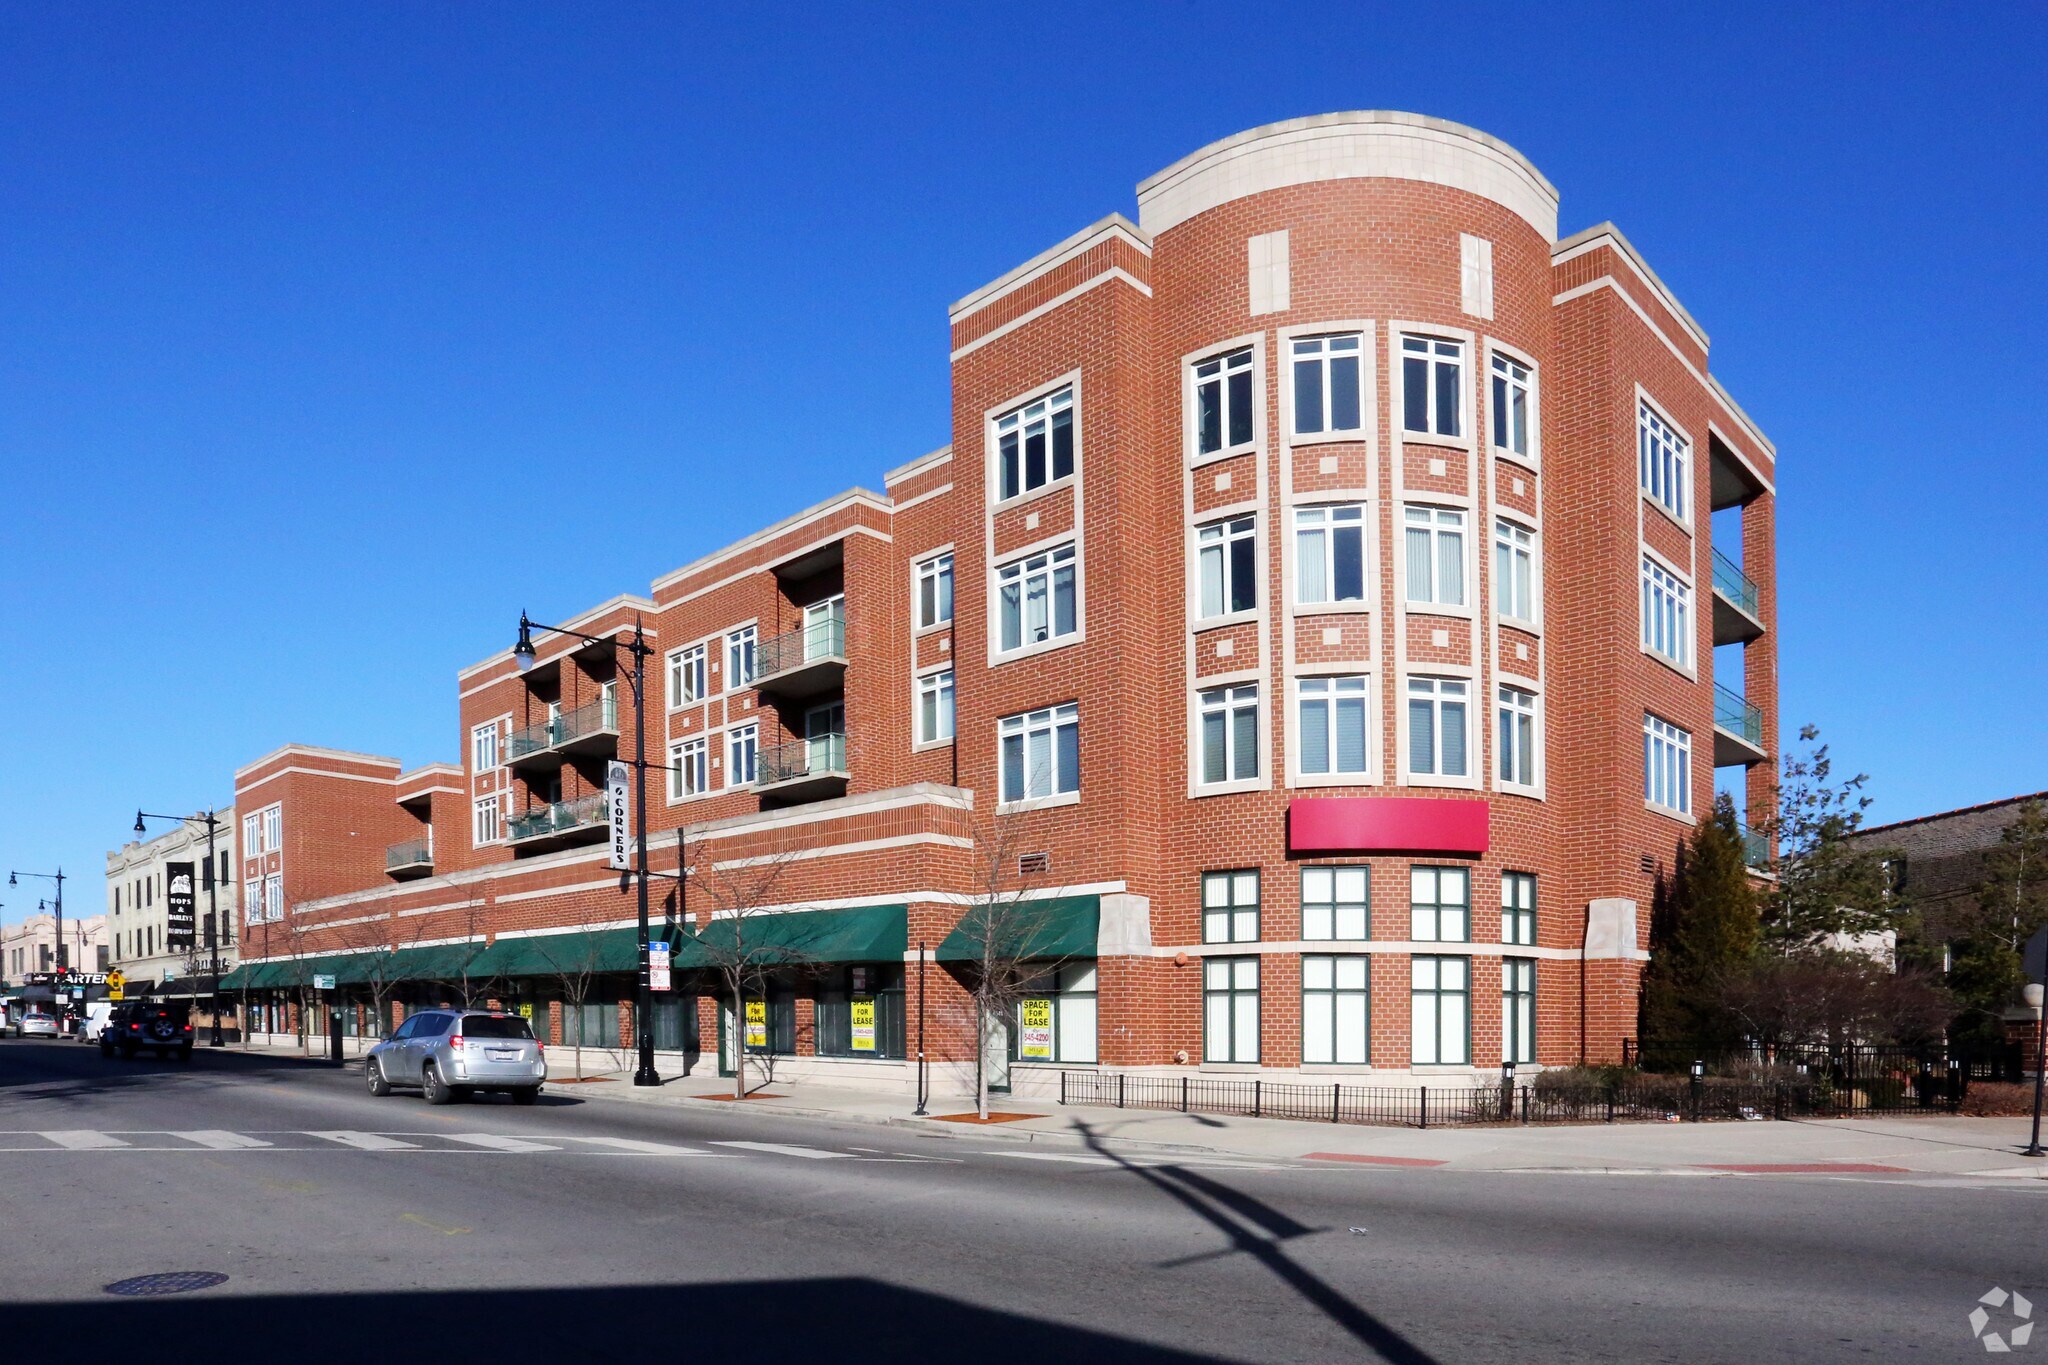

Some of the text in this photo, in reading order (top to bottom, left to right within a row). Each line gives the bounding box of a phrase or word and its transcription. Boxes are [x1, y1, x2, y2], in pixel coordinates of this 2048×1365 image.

[615, 798, 624, 863] CORNERS
[170, 897, 192, 905] HOPS
[1023, 1001, 1049, 1009] SPACE
[857, 1008, 869, 1016] FOR
[747, 1016, 764, 1024] LEASE
[852, 1017, 874, 1025] LEASE
[1023, 1018, 1049, 1026] LEASE
